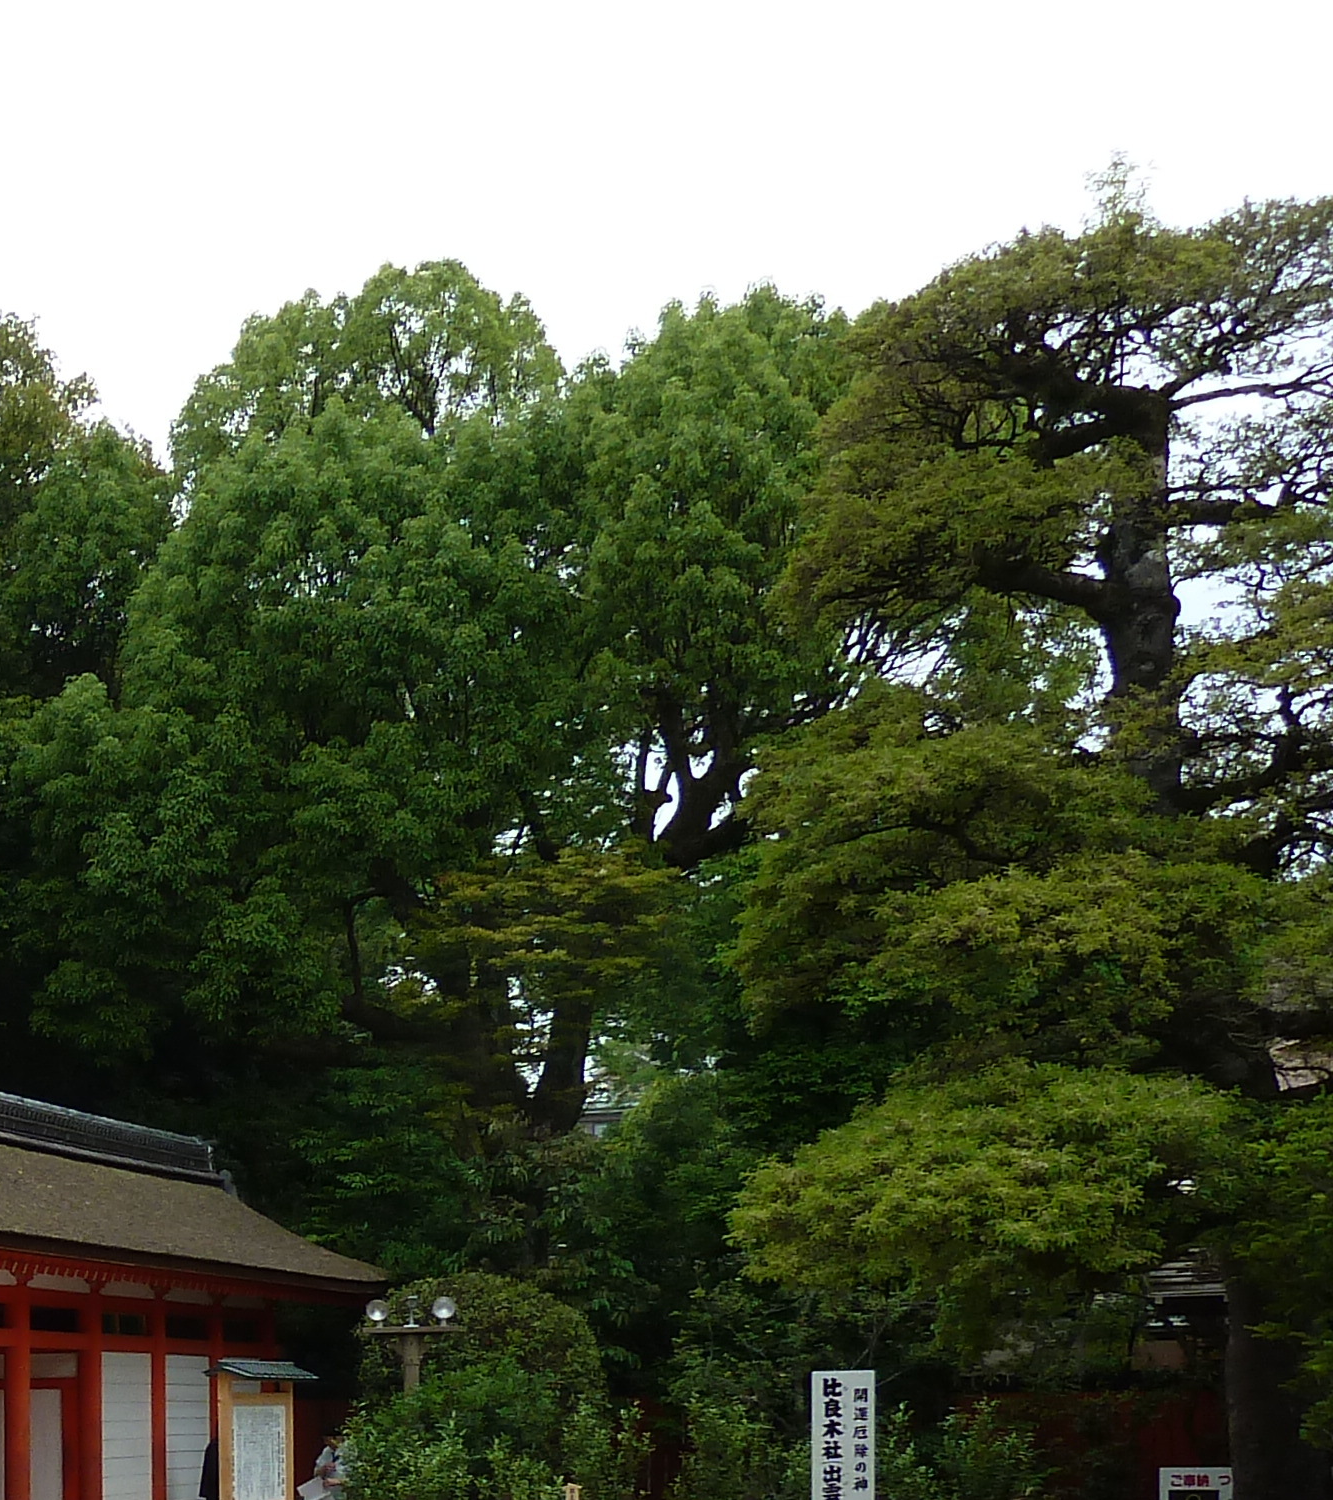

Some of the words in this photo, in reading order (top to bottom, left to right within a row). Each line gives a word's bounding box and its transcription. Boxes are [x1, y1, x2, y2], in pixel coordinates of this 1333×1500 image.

[852, 1387, 869, 1492] 開運厄除の神
